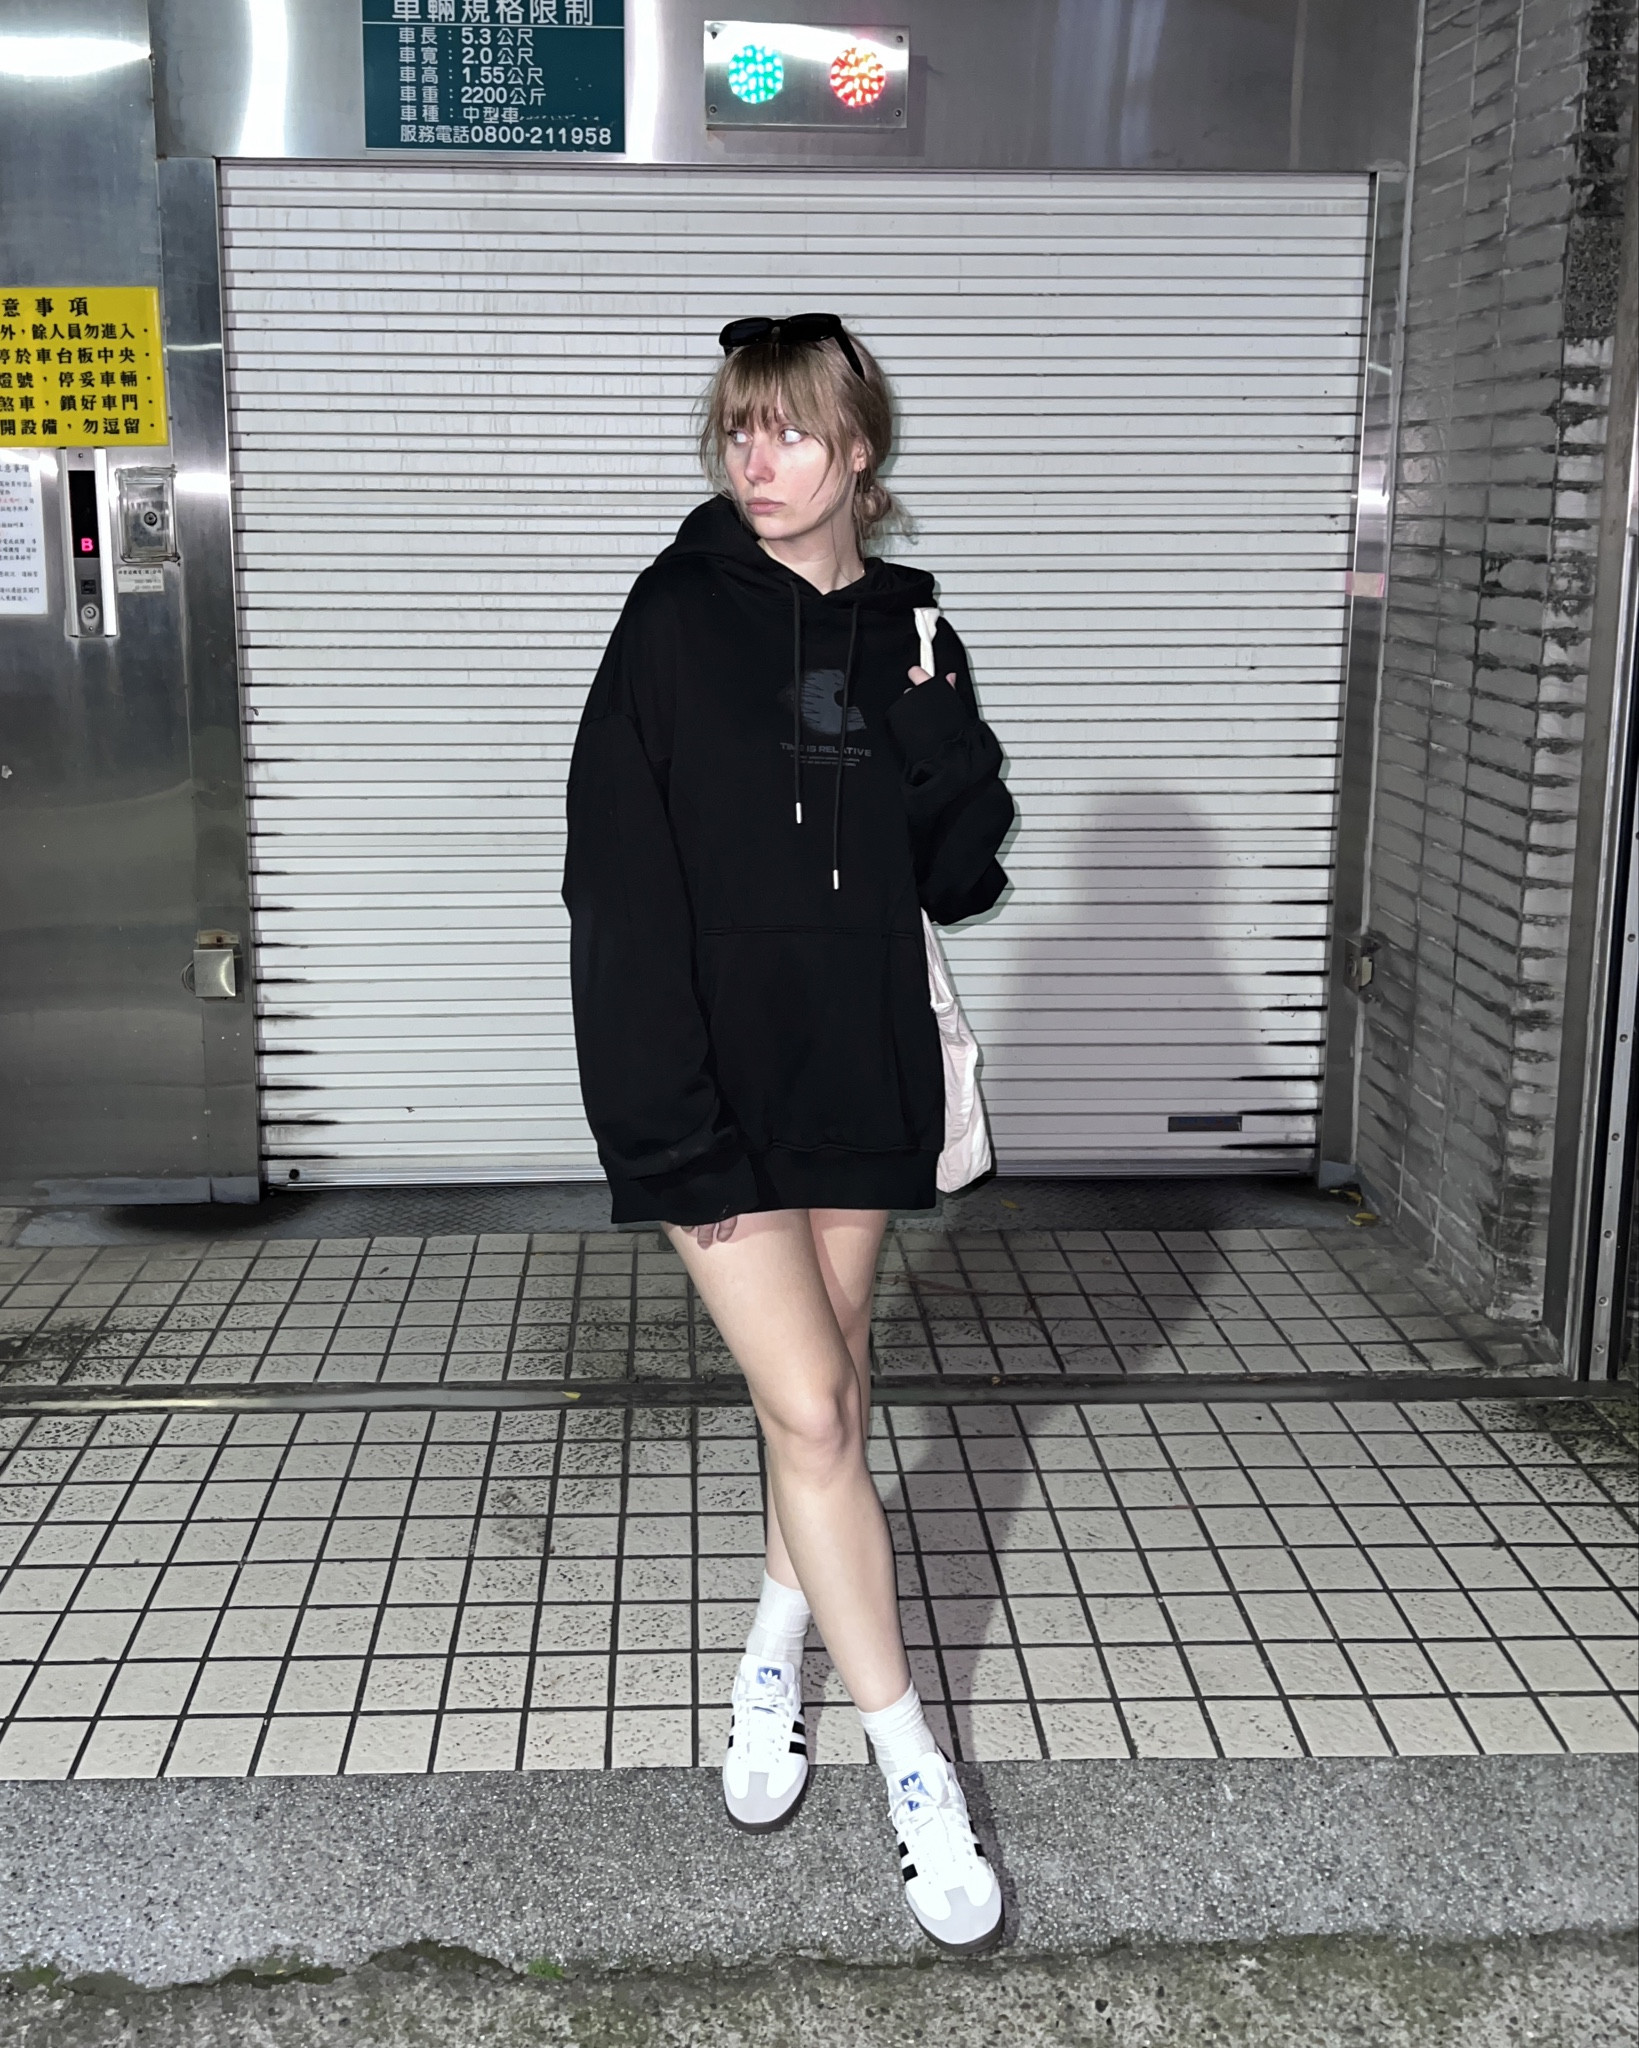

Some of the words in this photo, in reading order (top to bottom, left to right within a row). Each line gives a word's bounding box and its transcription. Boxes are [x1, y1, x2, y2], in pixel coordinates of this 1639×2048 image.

[392, 0, 594, 26] 車輛規格限制
[2, 297, 89, 317] 意事項
[81, 537, 94, 552] B
[806, 745, 817, 753] IS
